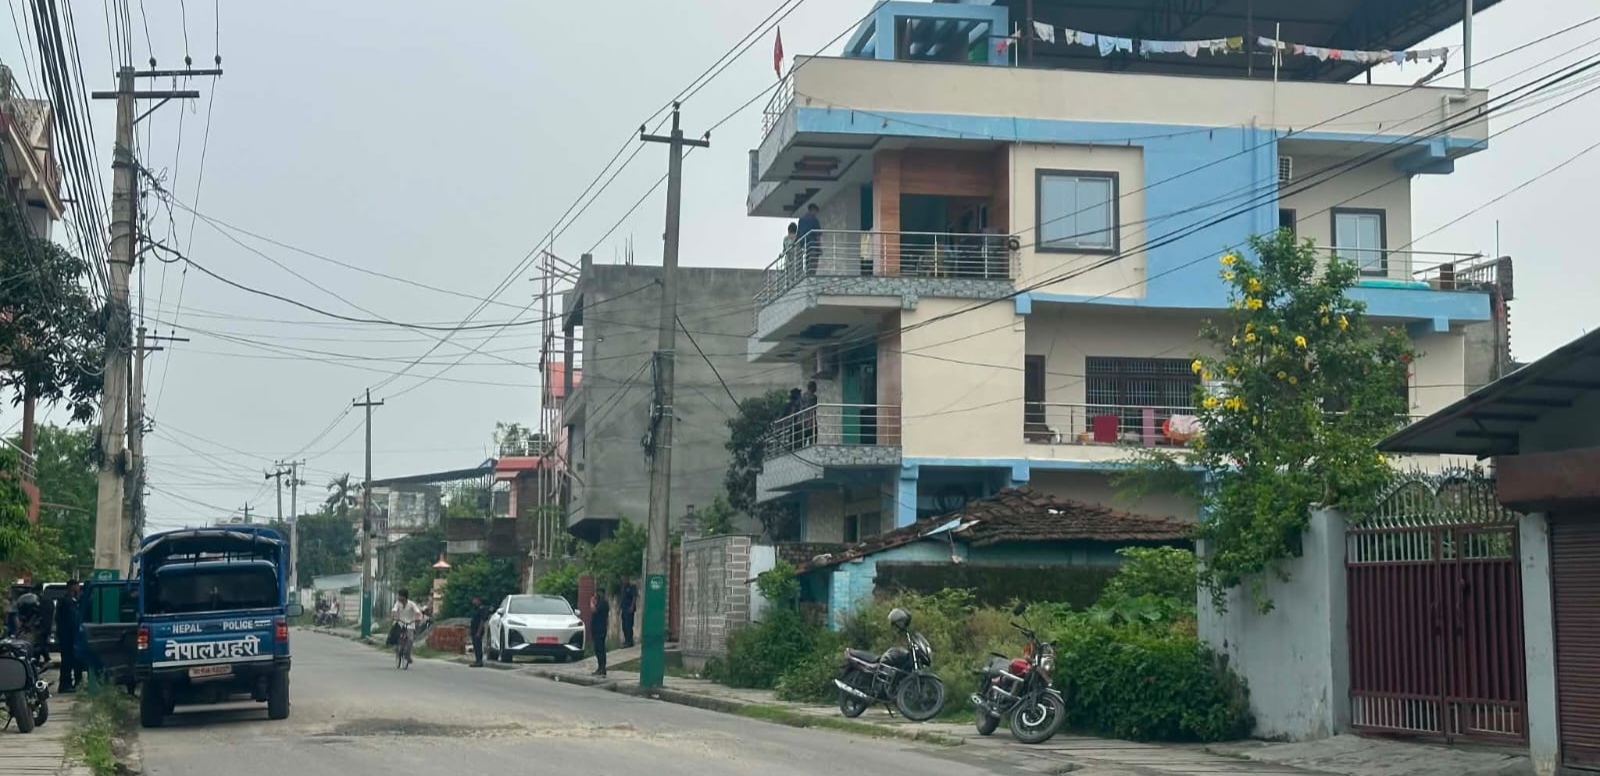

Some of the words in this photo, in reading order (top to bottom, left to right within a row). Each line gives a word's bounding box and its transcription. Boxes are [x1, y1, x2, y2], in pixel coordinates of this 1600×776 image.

[172, 623, 202, 634] NEPAL
[223, 620, 253, 630] POLICE
[165, 639, 215, 660] नेपाल
[216, 634, 260, 657] प्रहरी
